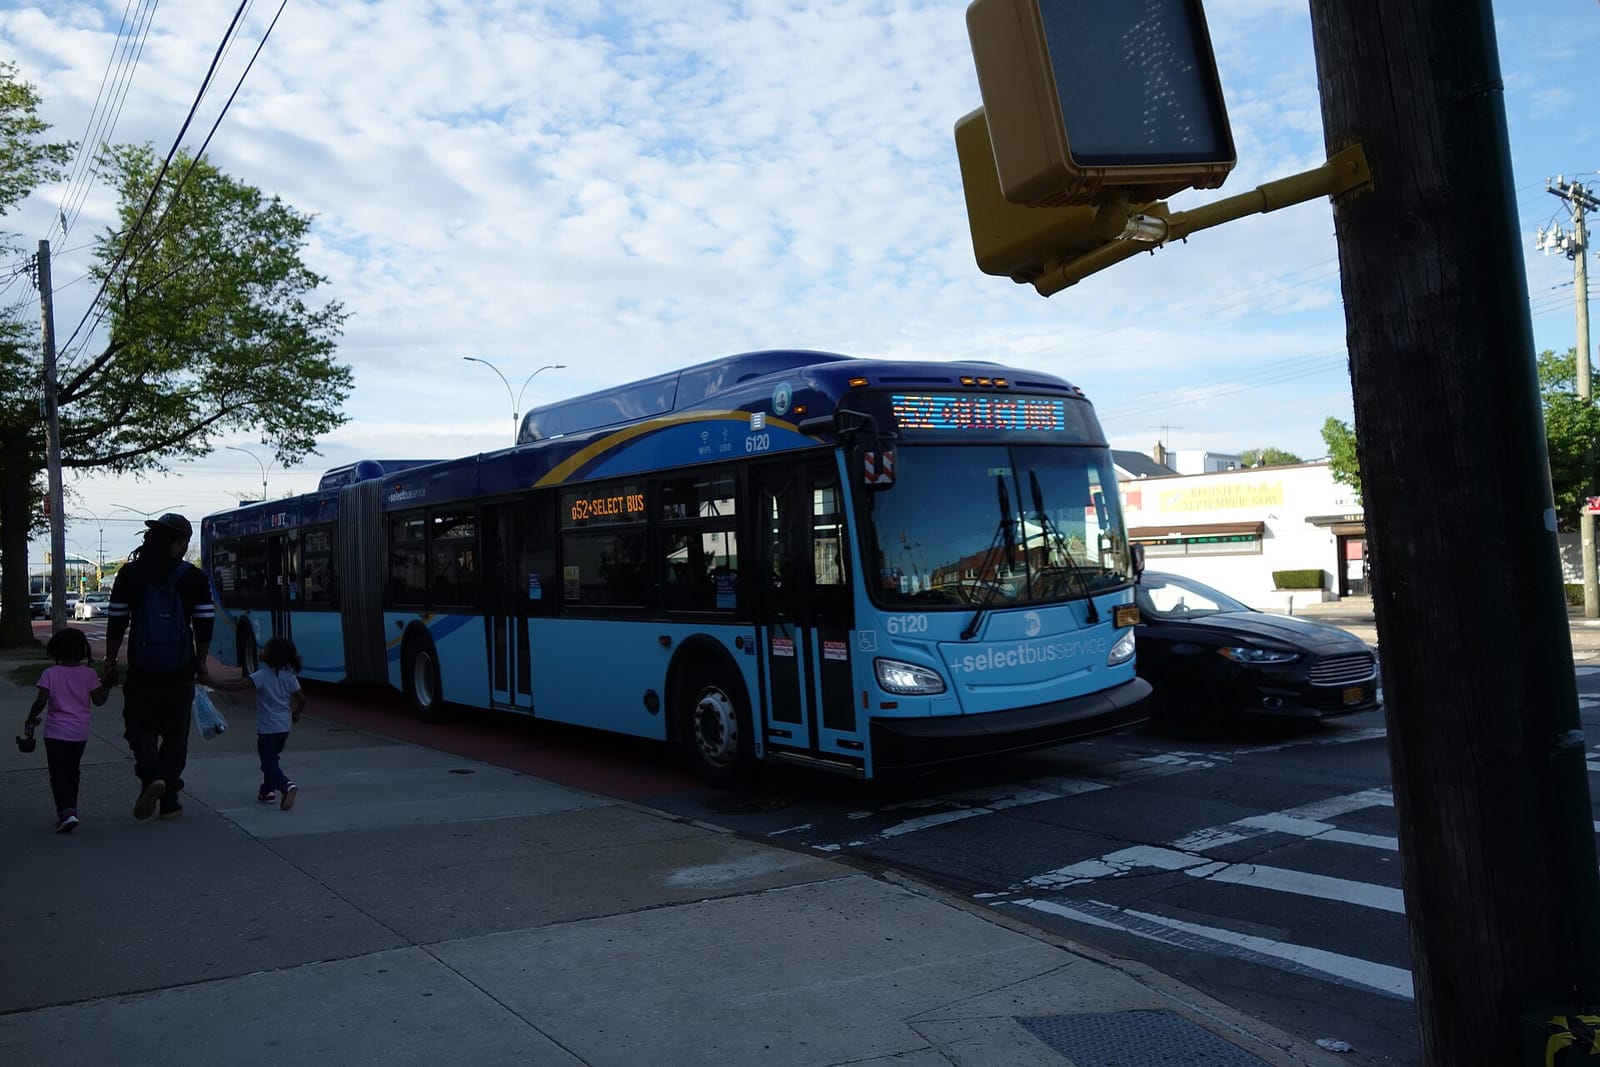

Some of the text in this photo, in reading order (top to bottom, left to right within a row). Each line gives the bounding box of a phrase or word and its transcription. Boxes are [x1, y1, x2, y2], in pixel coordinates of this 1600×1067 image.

[745, 433, 769, 452] 6120
[627, 494, 645, 513] BUS
[1184, 496, 1246, 511] SEPTEMBER
[887, 614, 928, 634] 6120
[824, 640, 847, 649] CAUTION
